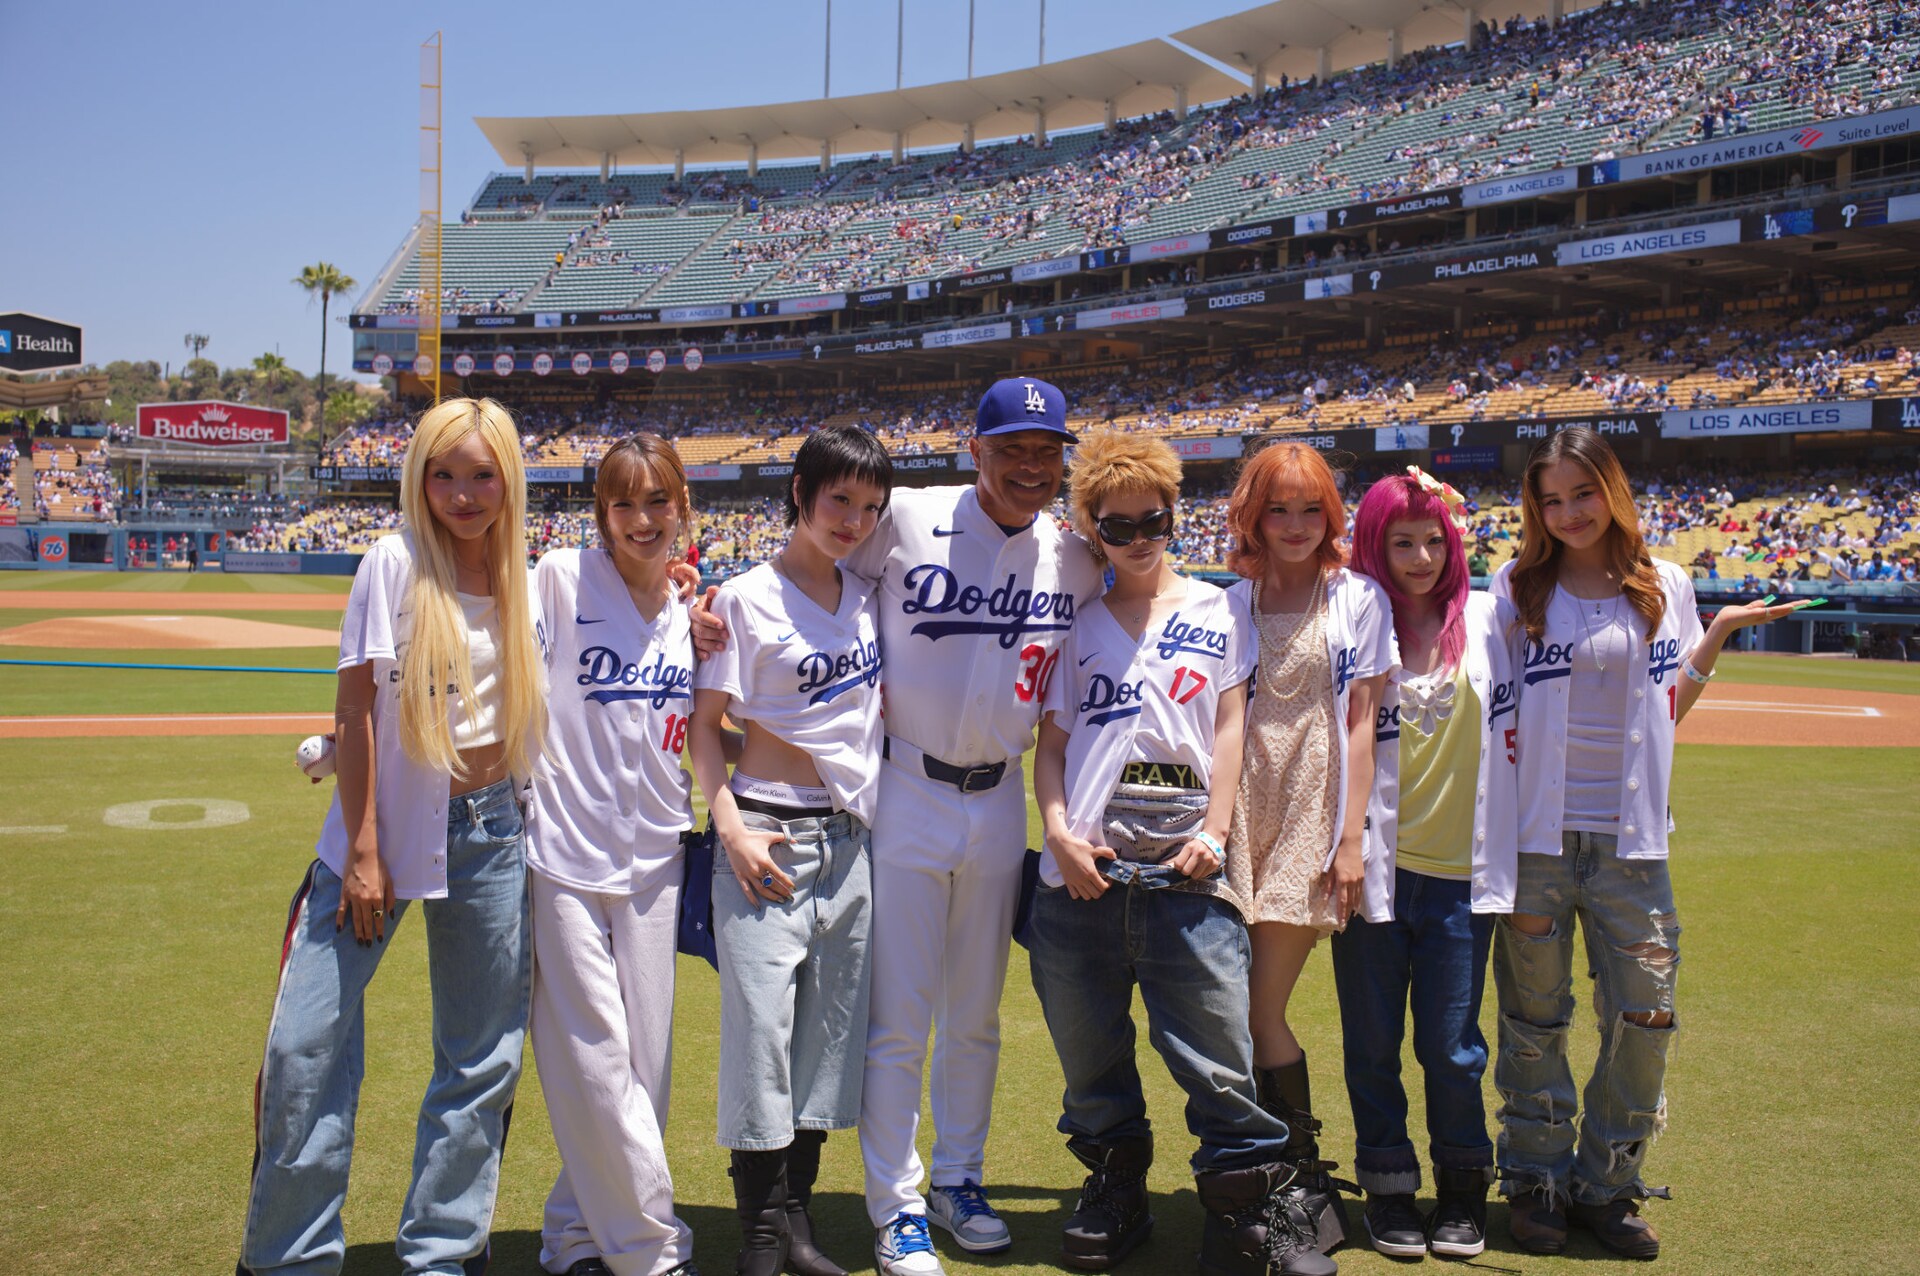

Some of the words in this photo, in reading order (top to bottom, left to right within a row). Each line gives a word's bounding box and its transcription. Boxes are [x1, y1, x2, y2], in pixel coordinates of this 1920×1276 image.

[1645, 158, 1685, 174] BANK
[1690, 154, 1709, 166] OF
[1712, 141, 1785, 164] AMERICA
[1838, 127, 1871, 141] Suite
[1875, 118, 1910, 136] Level
[1478, 186, 1503, 199] LOS
[1507, 175, 1565, 194] ANGELES
[1375, 195, 1450, 216] PHILADELPHIA
[1227, 226, 1273, 241] DODGERS
[1151, 241, 1189, 254] PHILLIES
[1580, 242, 1615, 259] LOS
[1621, 230, 1706, 254] ANGELES
[1021, 268, 1037, 277] LOS
[1039, 260, 1073, 272] ANGELES
[1435, 253, 1539, 278] PHILADELPHIA
[960, 273, 1006, 288] PHILADELPHIA
[860, 292, 892, 302] DODGERS
[1208, 291, 1265, 309] DODGERS
[599, 313, 652, 322] PHILADELPHIA
[671, 311, 687, 319] LOS
[689, 308, 724, 317] ANGELES
[1111, 306, 1160, 320] PHILLIES
[16, 335, 74, 353] Health
[934, 333, 953, 345] LOS
[955, 328, 996, 341] ANGELES
[855, 339, 914, 353] PHILADELPHIA
[1024, 383, 1046, 413] LA
[1689, 414, 1730, 431] LOS
[1738, 408, 1841, 428] ANGELES
[153, 417, 275, 442] Budweiser
[1171, 442, 1211, 456] ILLIES
[684, 467, 720, 478] HILLIES
[758, 465, 795, 476] DODGER
[44, 541, 65, 557] 76
[902, 564, 1074, 649] Dodgers
[797, 636, 882, 693] Dodg
[577, 646, 692, 710] Dodge
[1168, 666, 1208, 705] 17
[662, 713, 689, 754] 18
[746, 784, 770, 796] Calvin
[770, 789, 787, 799] Klein
[806, 793, 828, 802] Calvin
